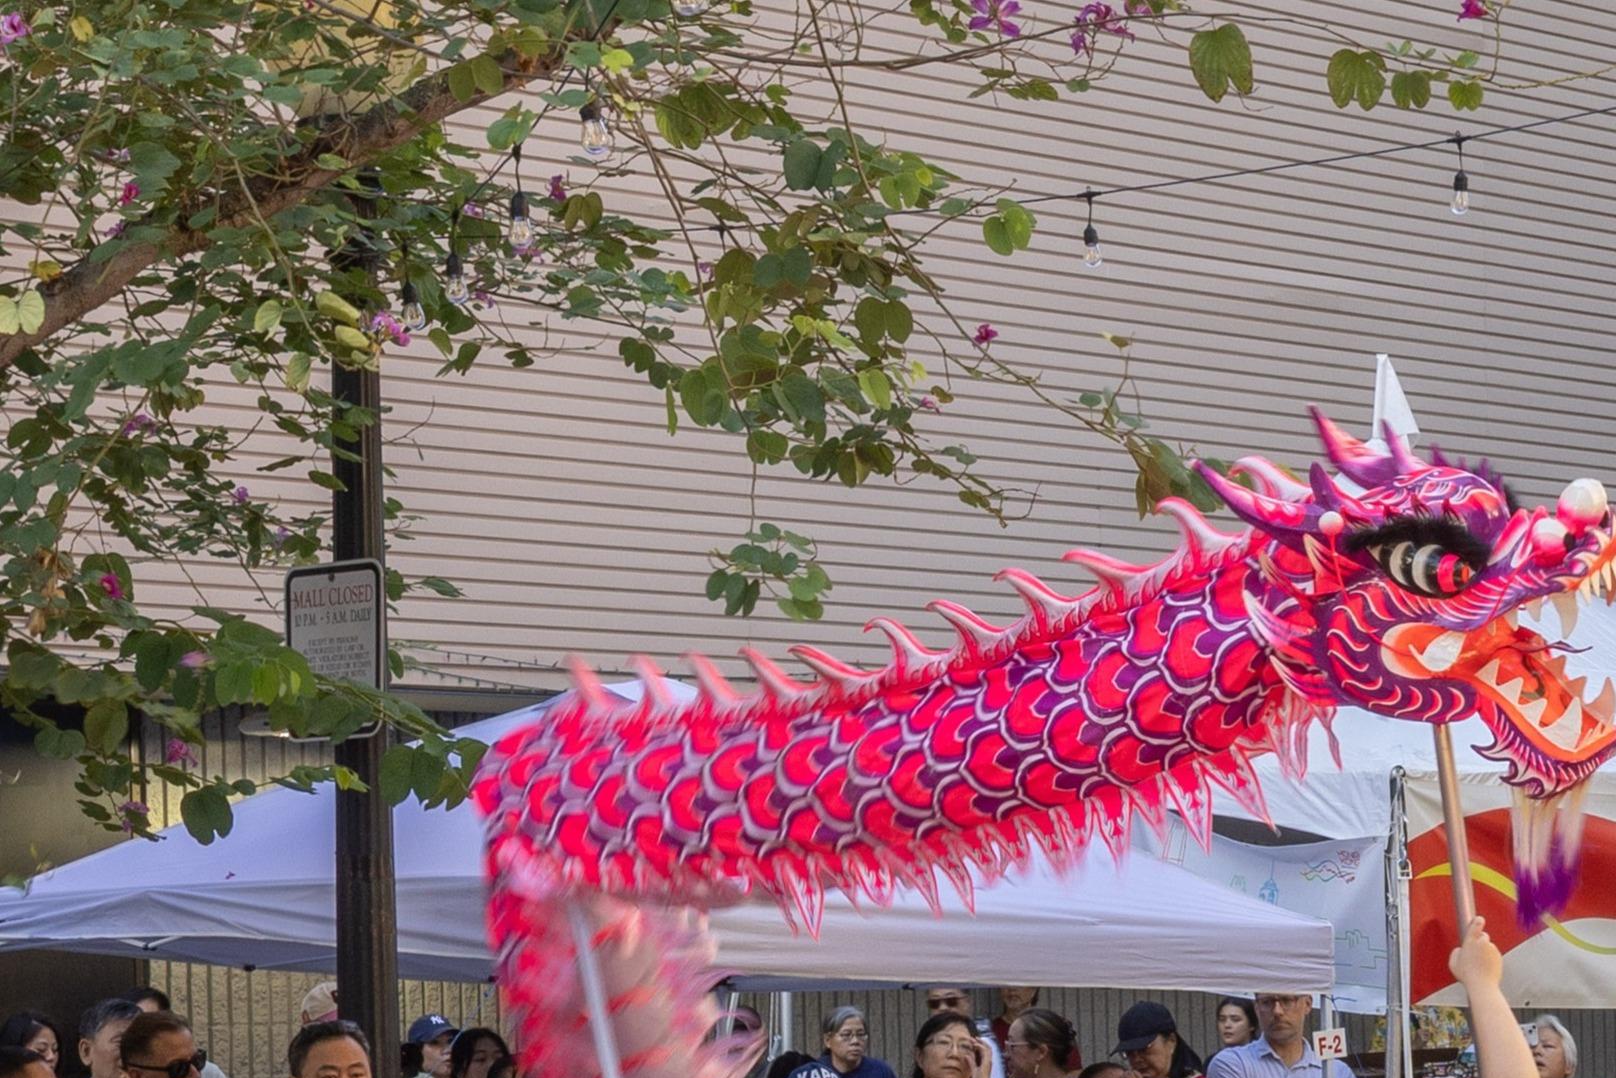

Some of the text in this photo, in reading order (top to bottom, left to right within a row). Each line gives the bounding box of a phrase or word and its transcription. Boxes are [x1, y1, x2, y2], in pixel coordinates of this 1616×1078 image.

[291, 583, 374, 609] MALL CLOSED
[1318, 1034, 1343, 1057] F-2
